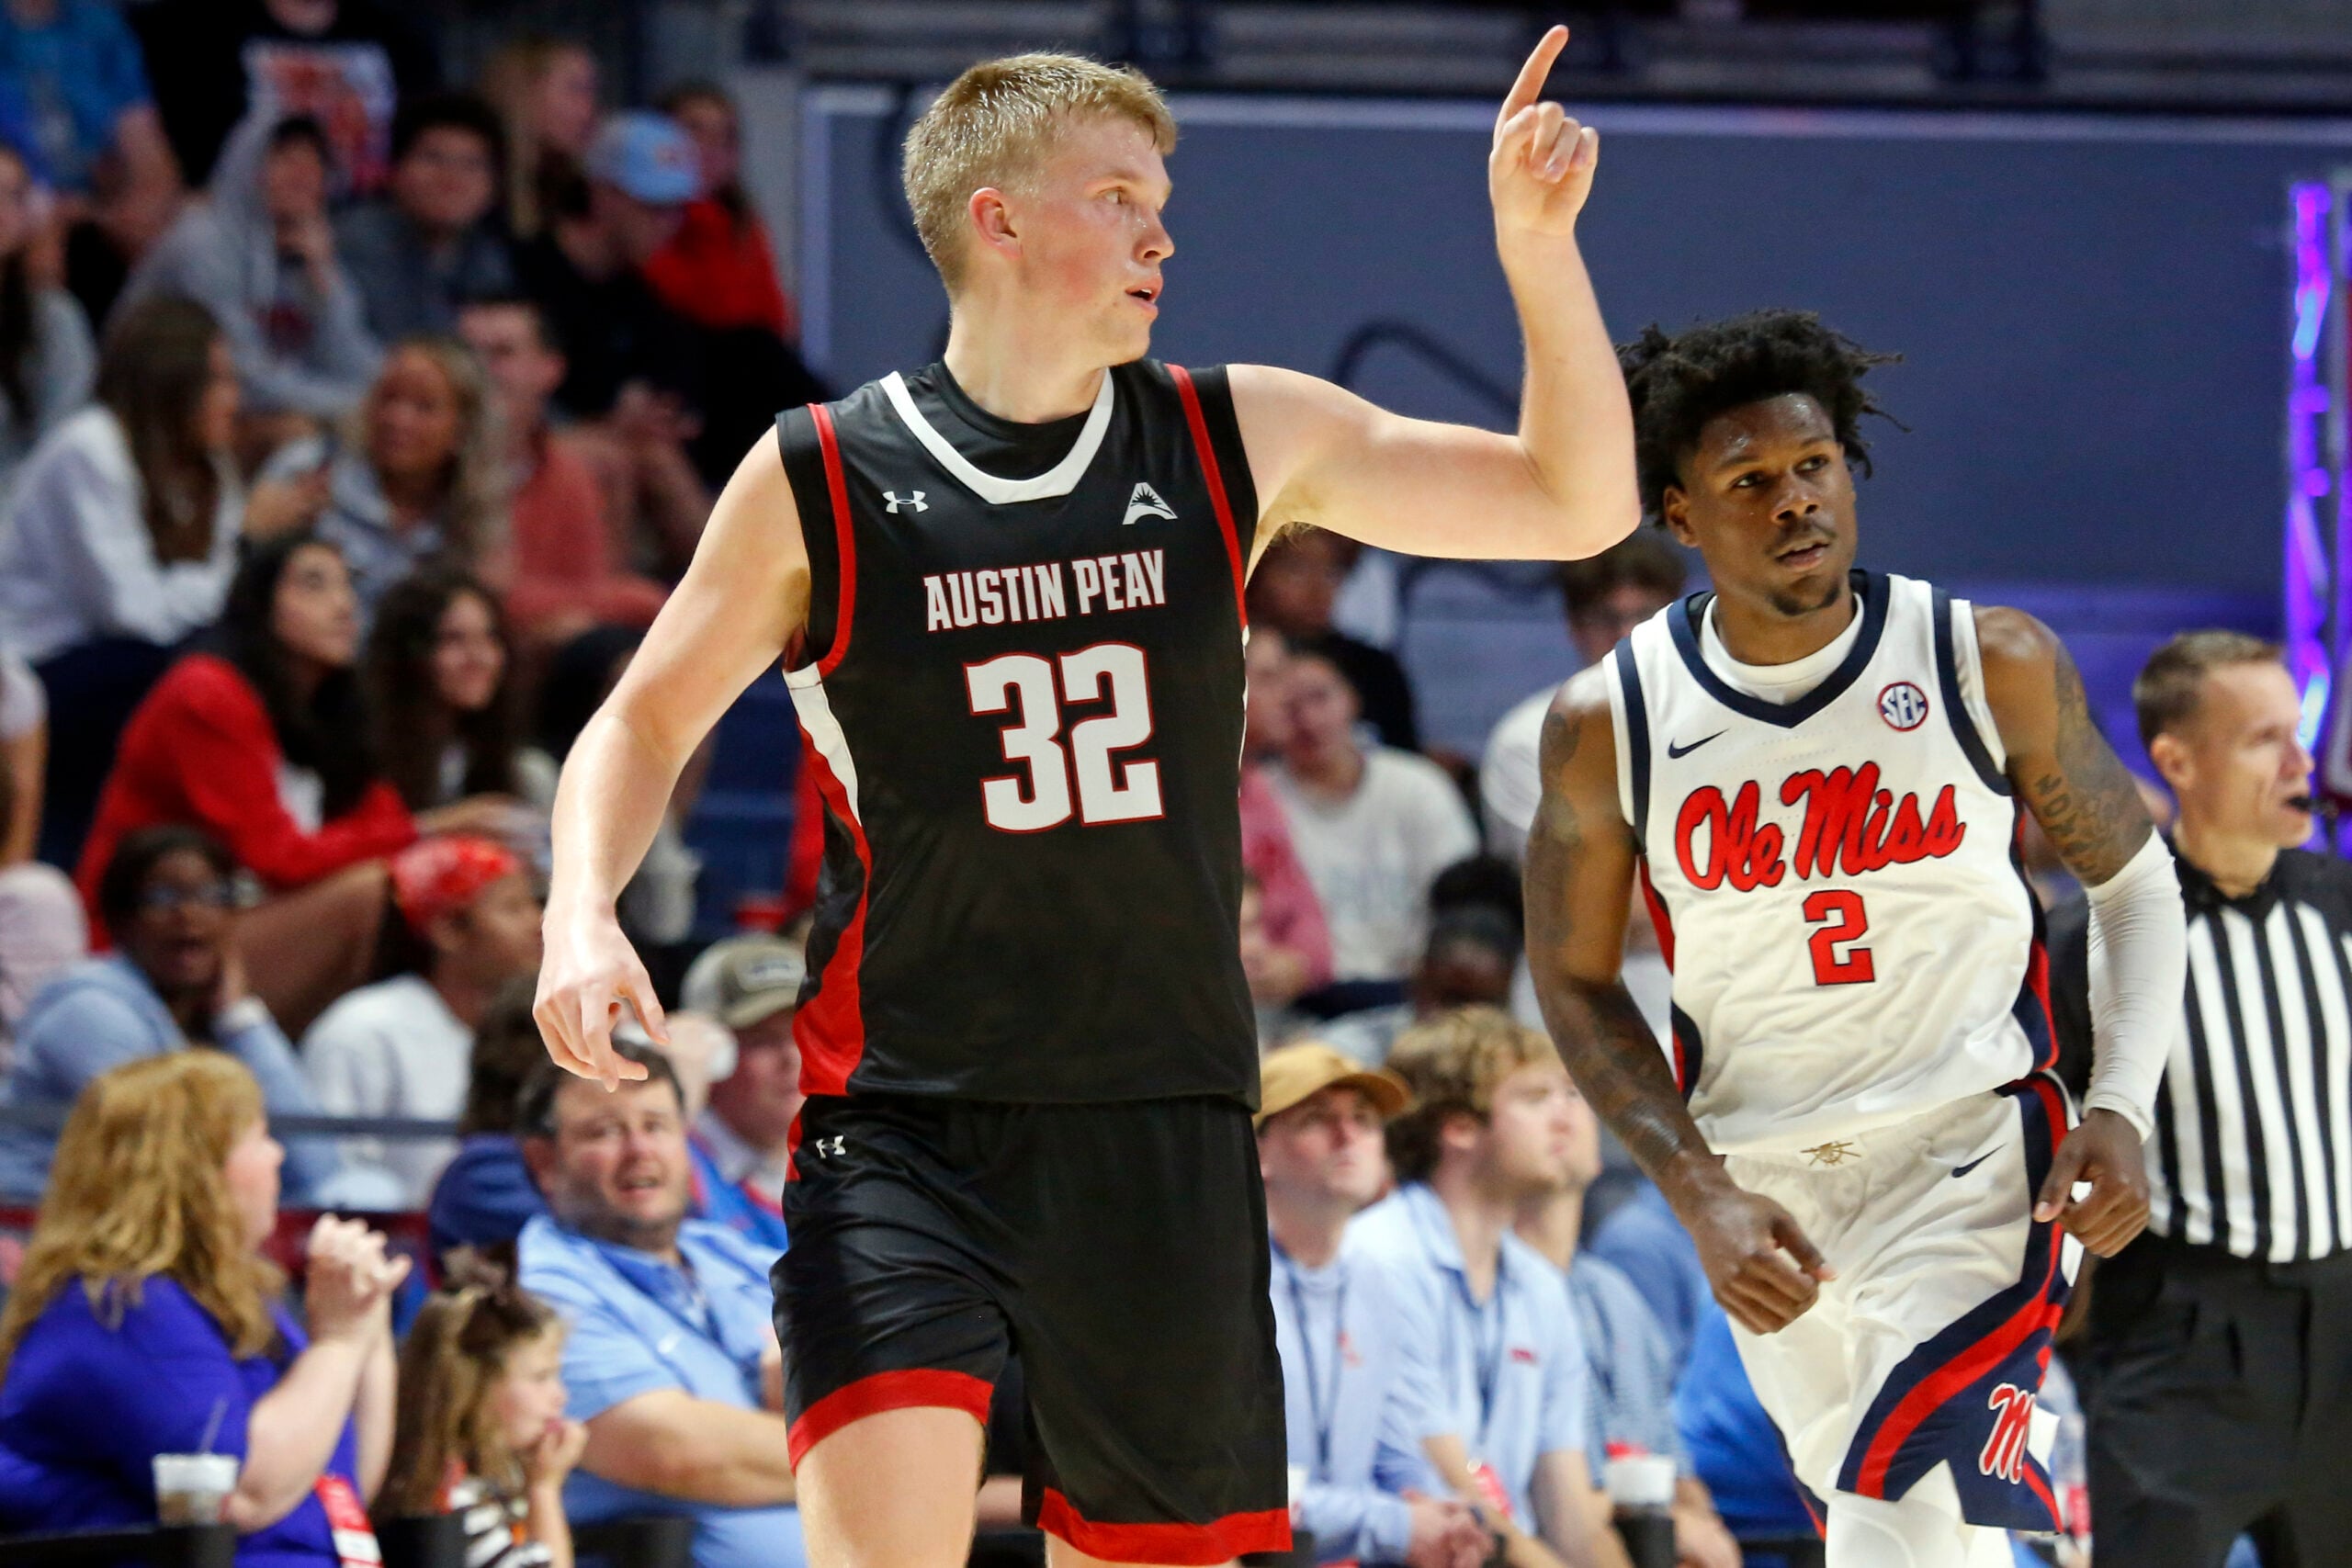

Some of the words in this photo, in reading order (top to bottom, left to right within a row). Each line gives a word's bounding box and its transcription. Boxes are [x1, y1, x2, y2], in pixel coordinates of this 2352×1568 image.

[923, 562, 1067, 632] AUSTIN
[1071, 548, 1166, 615] PEAY
[964, 641, 1164, 833] 32
[1882, 684, 1926, 728] SEC
[1675, 780, 1786, 892] Ole
[1780, 761, 1967, 880] Miss
[1802, 889, 1875, 987] 2
